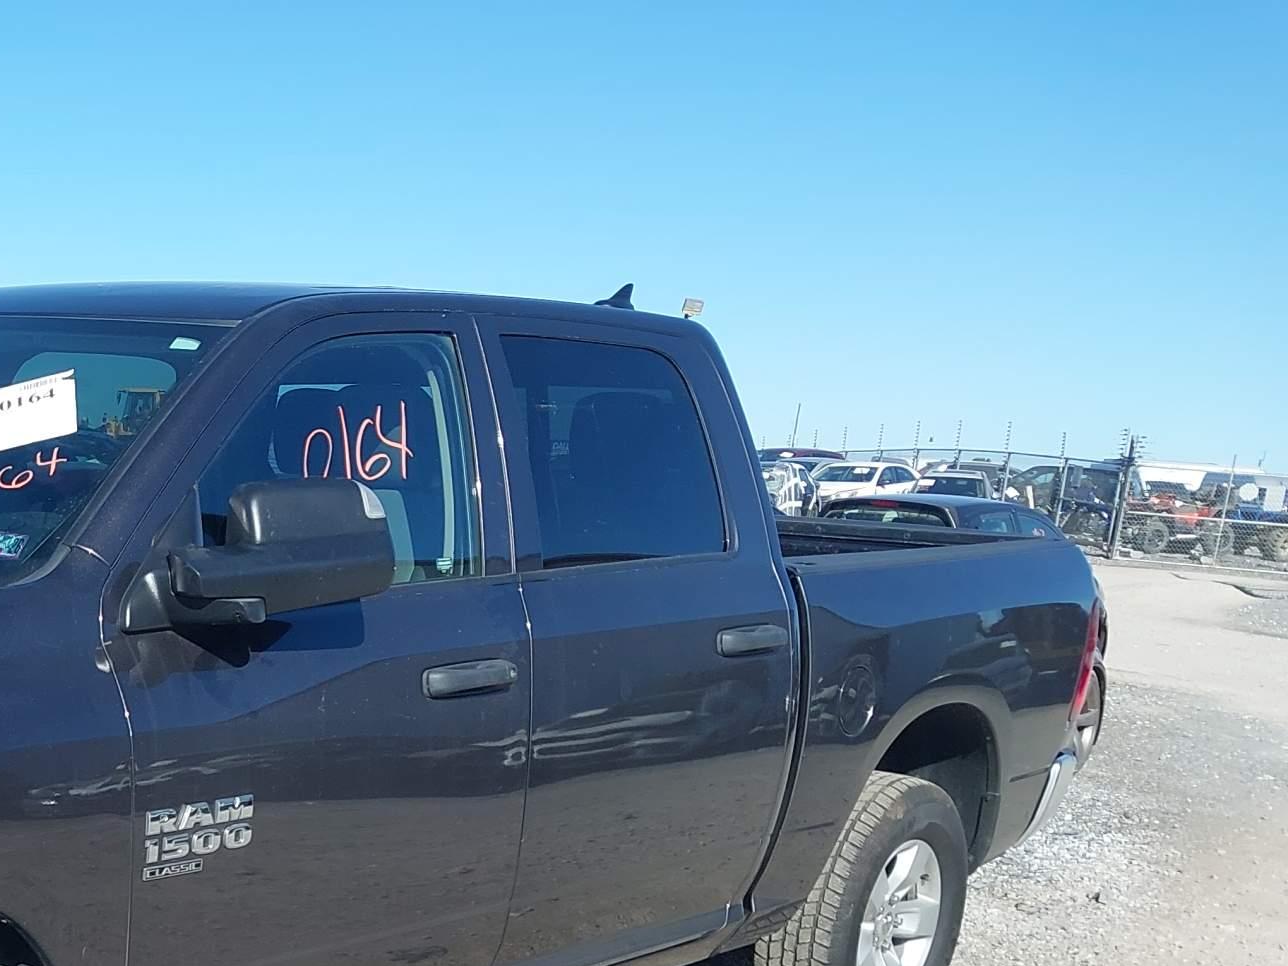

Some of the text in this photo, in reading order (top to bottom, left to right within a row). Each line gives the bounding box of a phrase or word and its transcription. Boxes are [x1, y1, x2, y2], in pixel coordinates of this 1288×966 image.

[303, 400, 414, 481] 0164
[145, 794, 254, 836] RAM
[145, 823, 252, 863] 1500
[145, 861, 201, 879] CLASSIC
